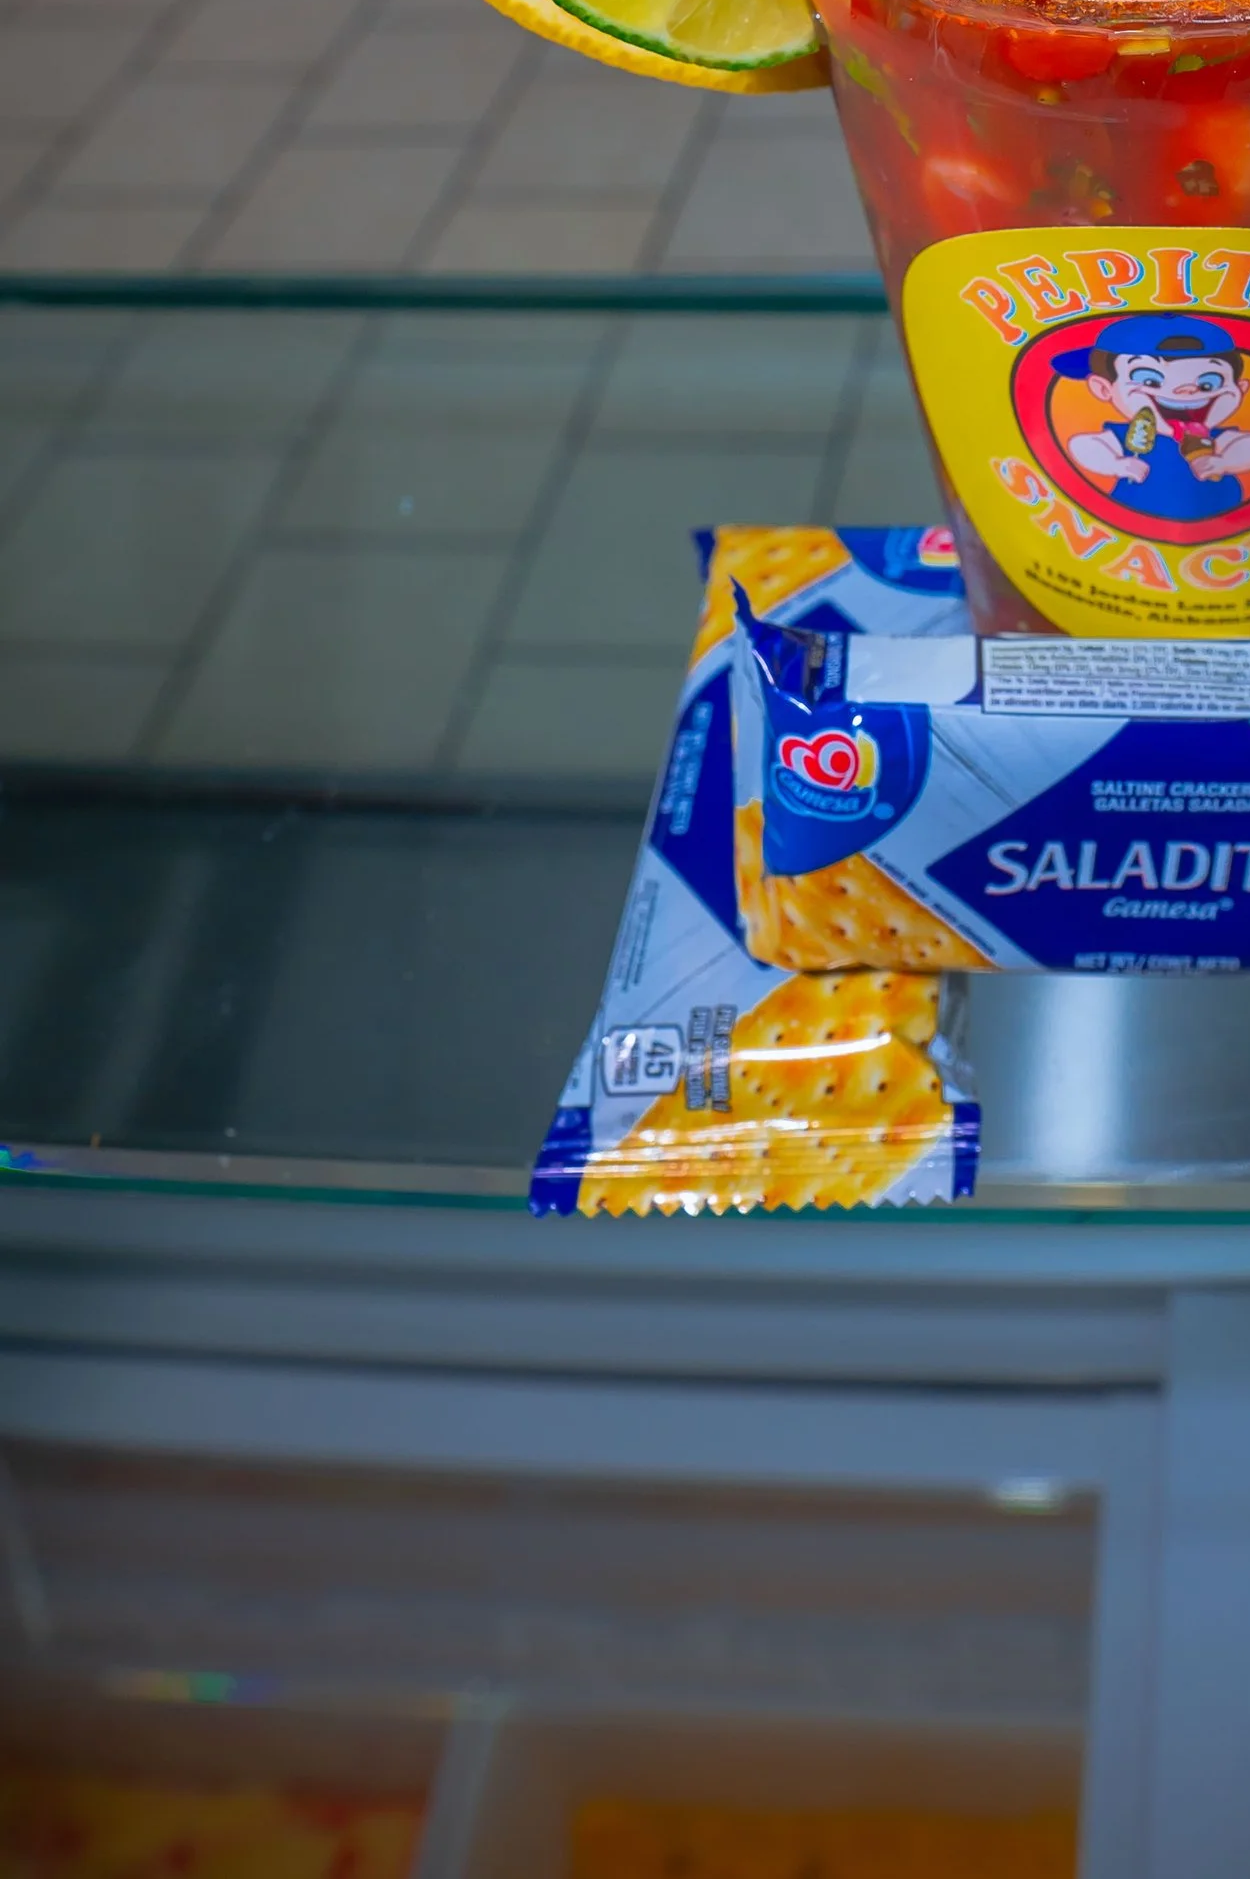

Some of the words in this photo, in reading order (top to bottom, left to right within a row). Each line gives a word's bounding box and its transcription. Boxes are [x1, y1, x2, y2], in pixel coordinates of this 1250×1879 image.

[1091, 779, 1167, 798] SALTINE
[1094, 796, 1185, 813] GALLETAS
[642, 1040, 676, 1080] 45
